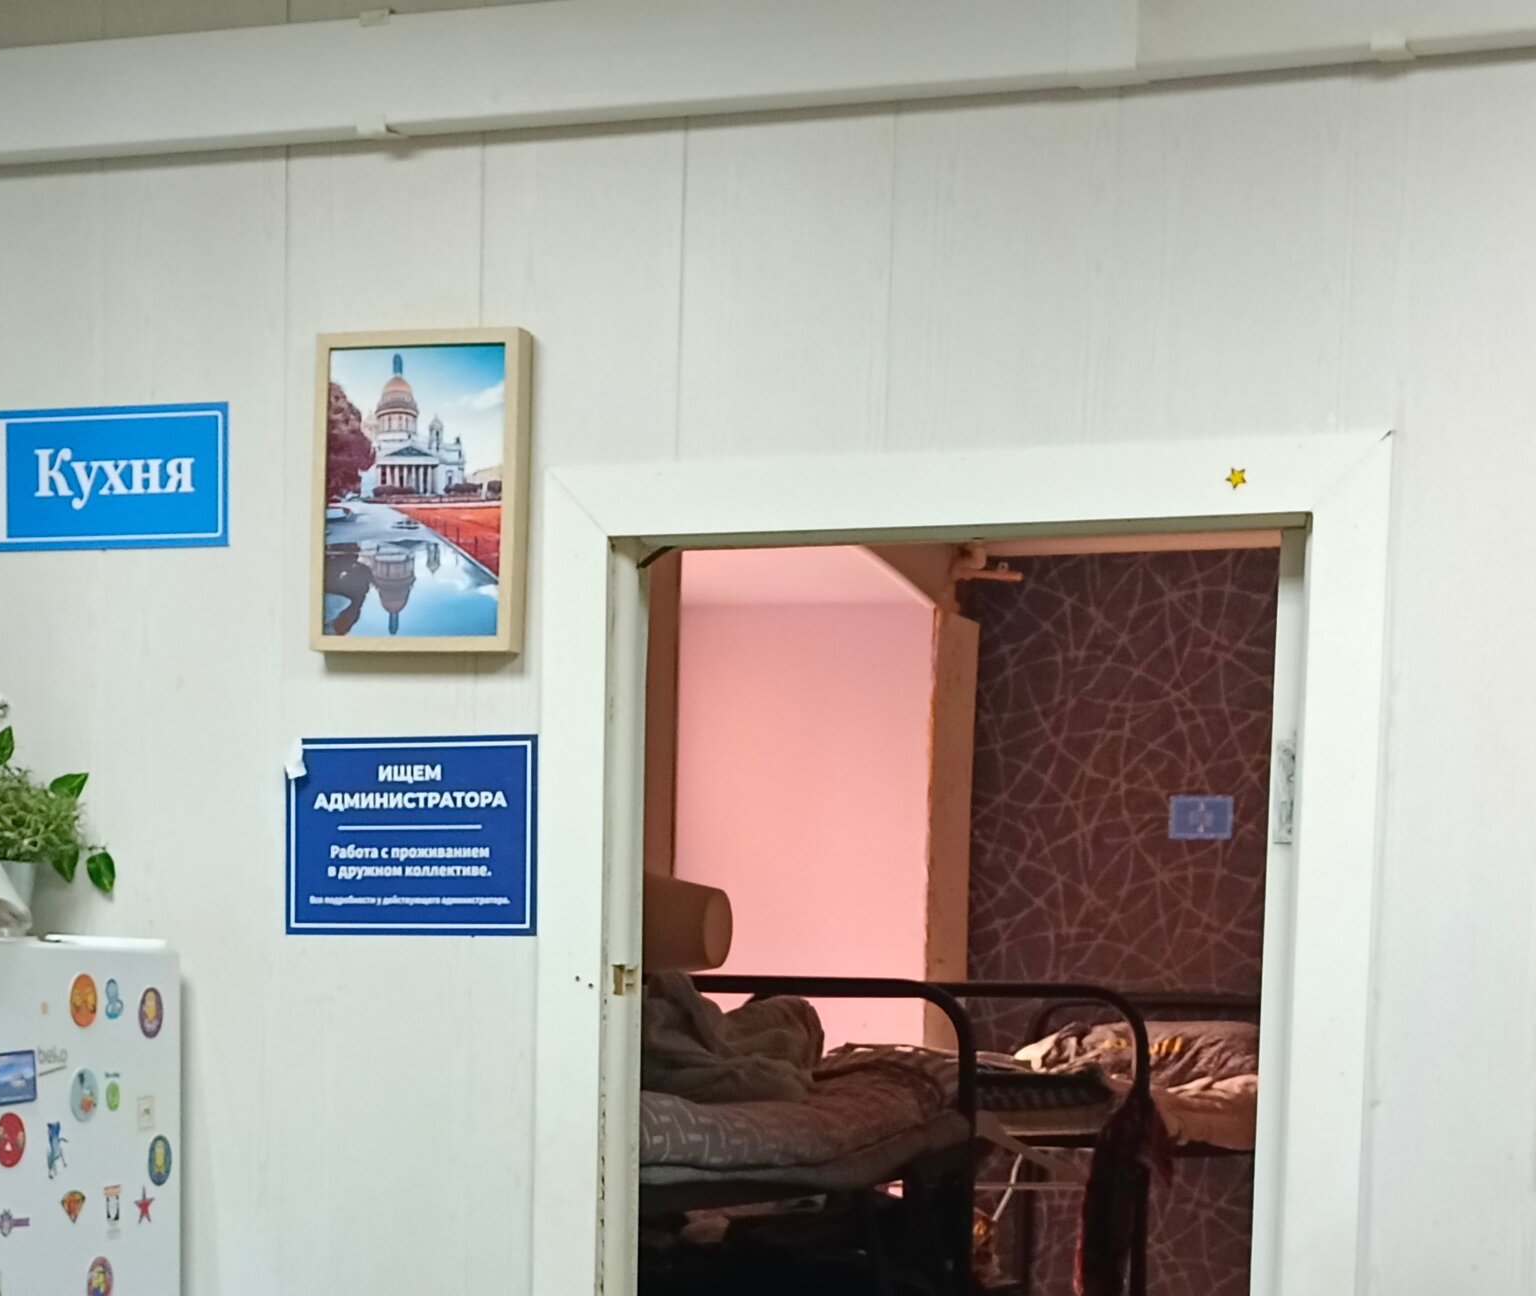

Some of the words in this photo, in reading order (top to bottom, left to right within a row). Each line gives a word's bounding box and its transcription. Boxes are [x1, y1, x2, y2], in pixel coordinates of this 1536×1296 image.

[34, 448, 195, 510] Кухня
[378, 764, 442, 784] ИЩЕМ
[313, 791, 508, 811] АДМИНИСТРАТОРА
[330, 844, 379, 860] Работа
[381, 848, 389, 859] с
[391, 846, 490, 862] проживанием
[338, 864, 403, 880] дружном
[405, 864, 492, 878] коллективе.
